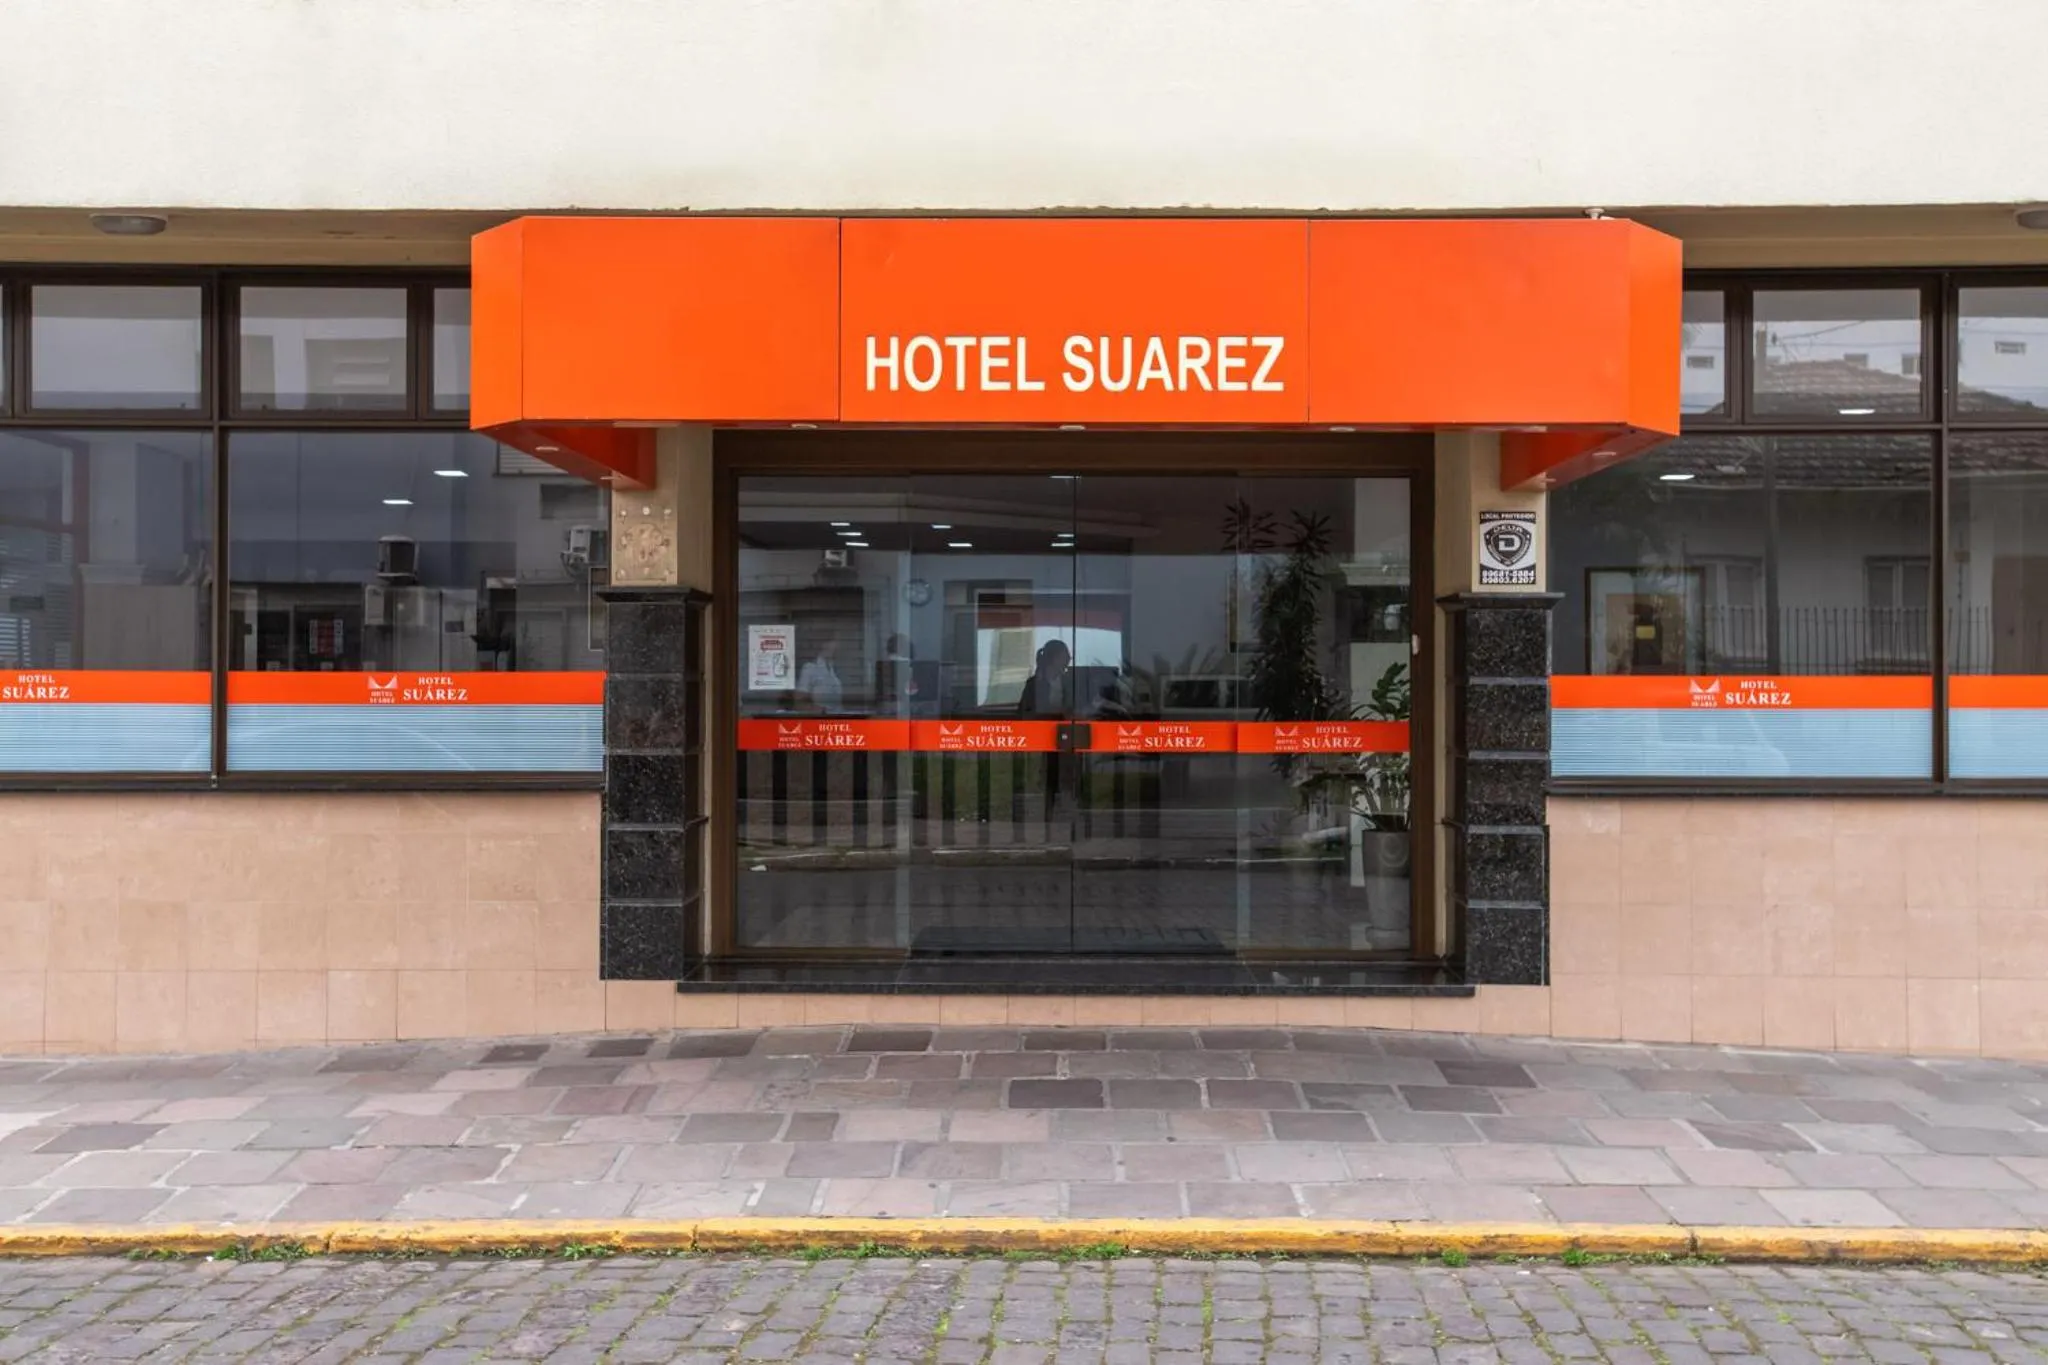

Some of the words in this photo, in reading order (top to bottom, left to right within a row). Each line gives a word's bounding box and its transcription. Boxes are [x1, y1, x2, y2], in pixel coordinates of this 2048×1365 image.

[865, 336, 1045, 392] HOTEL
[1062, 335, 1285, 392] SUAREZ
[18, 674, 56, 684] HOTEL
[418, 677, 454, 685] HOTEL
[1740, 680, 1777, 689] HOTEL
[2, 683, 71, 699] SUÁREZ
[403, 684, 468, 701] SUÁREZ
[1725, 688, 1792, 705] SUÁREZ
[819, 723, 852, 732] HOTEL
[980, 725, 1014, 733] HOTEL
[1158, 725, 1191, 734] HOTEL
[1315, 726, 1348, 734] HOTEL
[804, 732, 866, 746] SUÁREZ
[966, 732, 1027, 748] SUÁREZ
[1144, 733, 1205, 748] SUÁREZ
[1302, 734, 1364, 749] SUÁREZ
